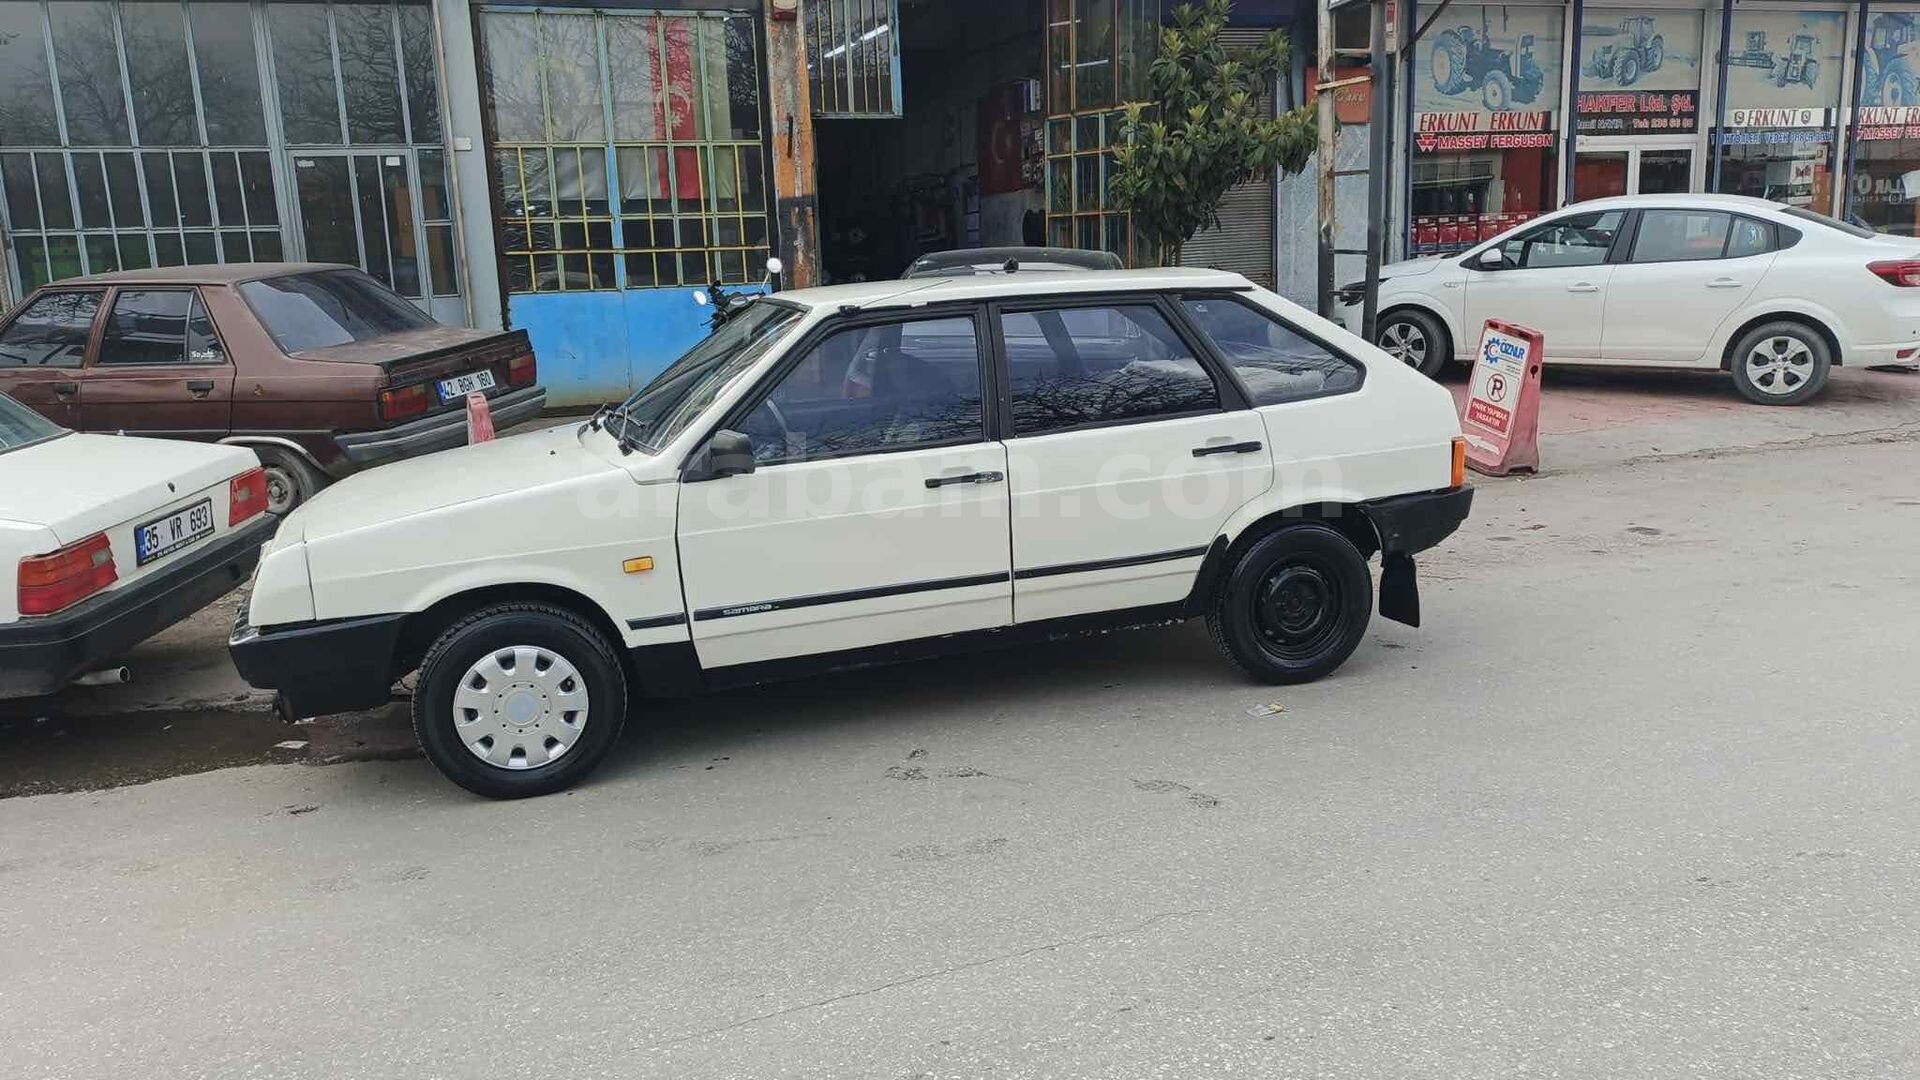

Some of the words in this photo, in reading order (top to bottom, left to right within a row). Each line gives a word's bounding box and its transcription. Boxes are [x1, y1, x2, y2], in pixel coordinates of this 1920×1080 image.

[1419, 112, 1479, 132] ERKUNT
[1490, 111, 1546, 130] ERKUNT
[1748, 109, 1799, 127] ERKUNT
[1859, 106, 1899, 124] RKUNT
[1438, 136, 1488, 149] MASSEY
[1490, 134, 1553, 148] FERGUSON
[145, 526, 159, 552] 35
[170, 517, 183, 541] VR
[190, 506, 208, 532] 693
